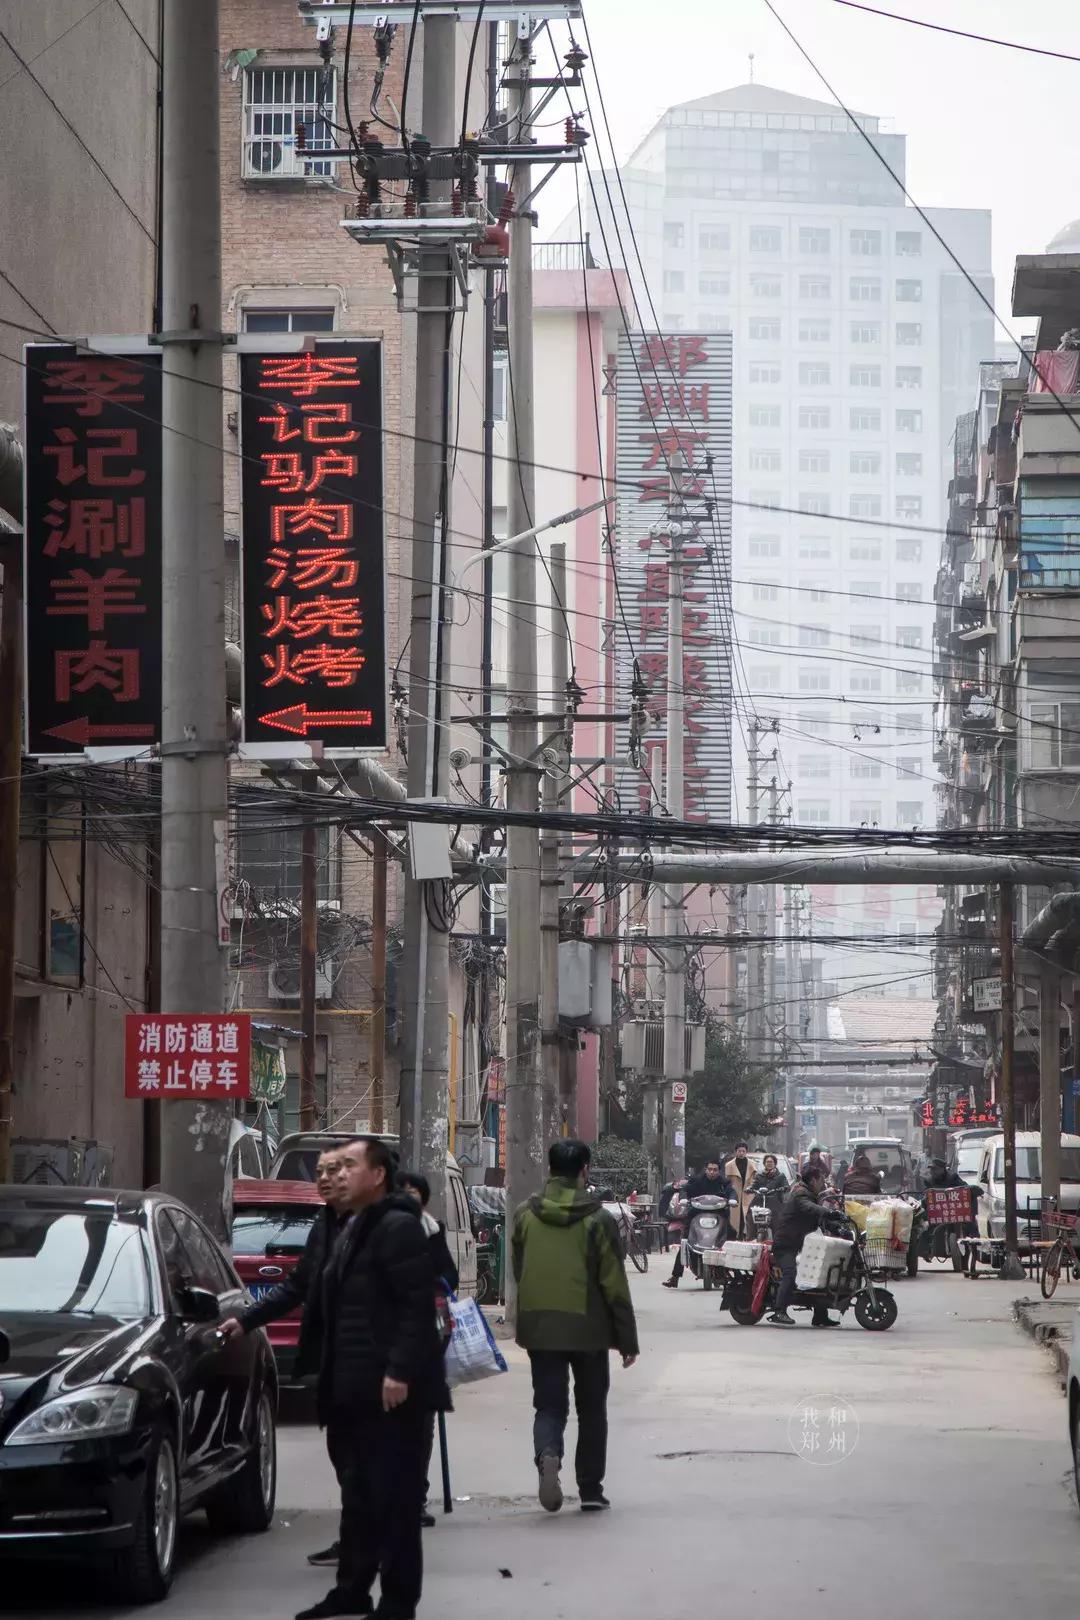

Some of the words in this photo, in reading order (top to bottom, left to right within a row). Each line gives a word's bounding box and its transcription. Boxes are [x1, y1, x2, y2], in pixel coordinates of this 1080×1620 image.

[42, 361, 146, 701] 李记涮羊肉
[260, 353, 366, 687] 李记驴肉汤烧烤
[138, 1022, 239, 1054] 消防通道
[138, 1059, 239, 1091] 禁止停车
[935, 1191, 960, 1202] 回收
